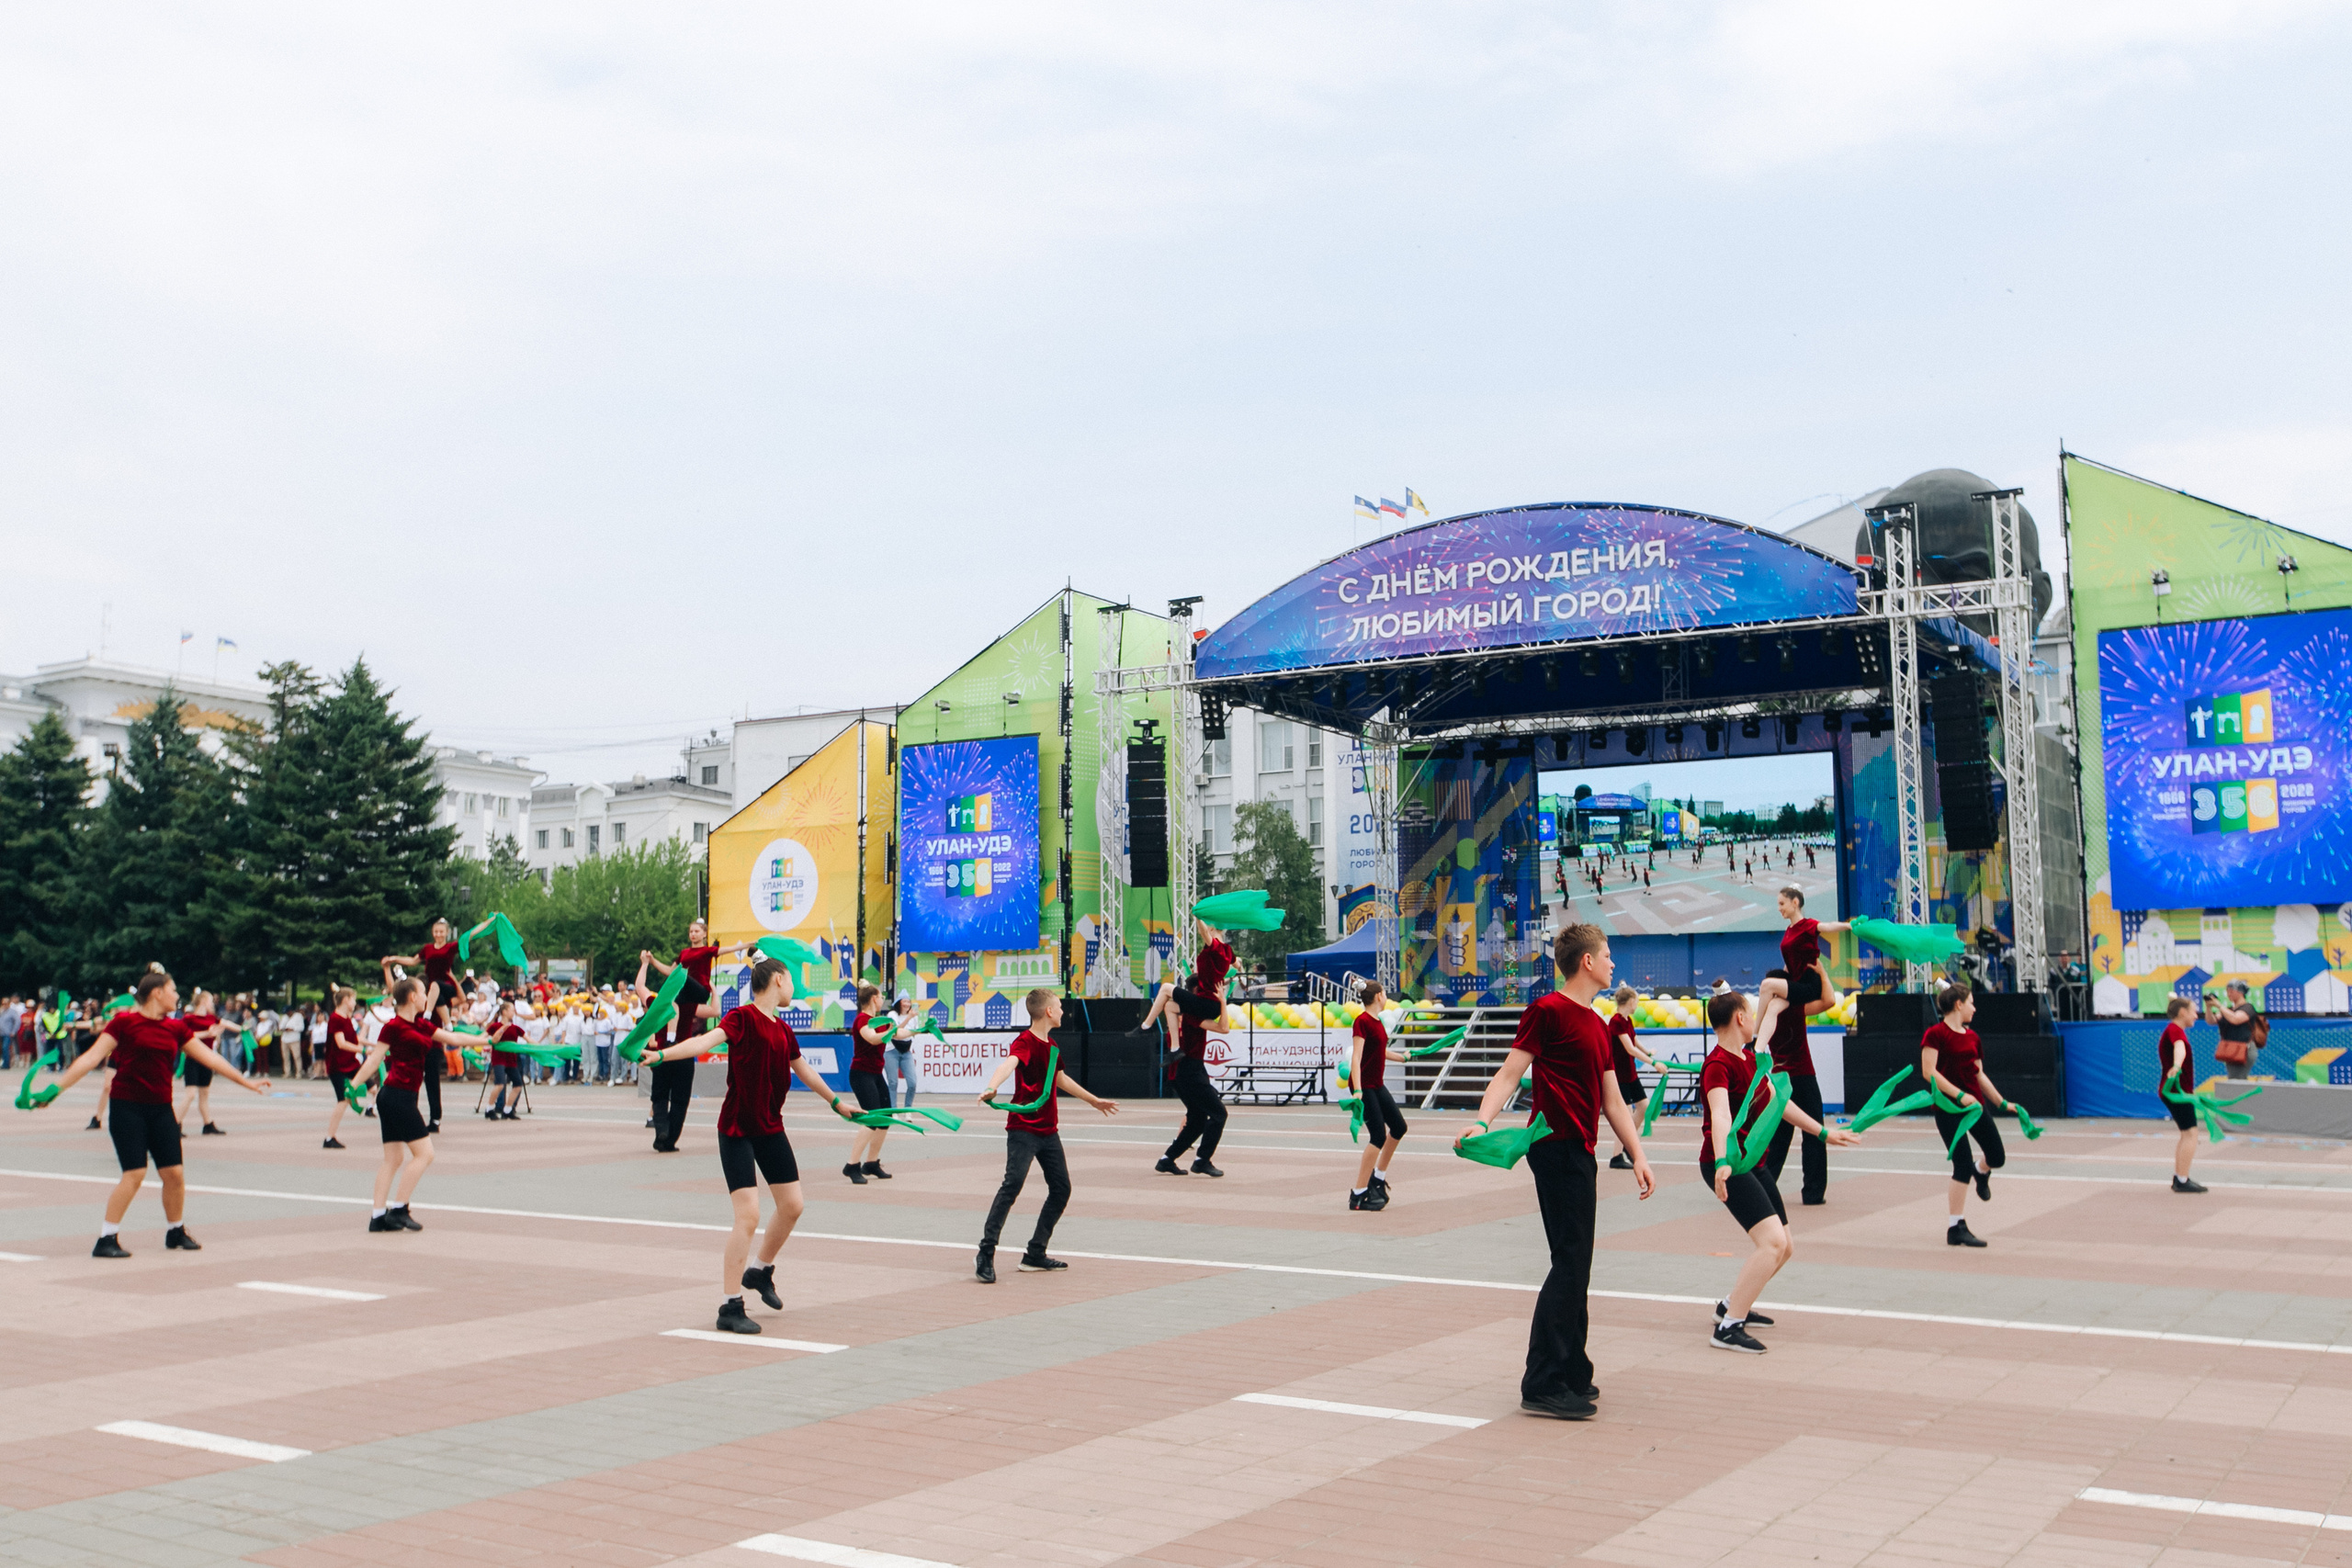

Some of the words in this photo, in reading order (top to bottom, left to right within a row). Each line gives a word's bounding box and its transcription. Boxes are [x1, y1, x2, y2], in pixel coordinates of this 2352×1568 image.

[1338, 578, 1360, 604] С
[1366, 564, 1458, 604] ДНЁМ
[1468, 539, 1675, 588] РОЖДЕНИЯ,
[1348, 593, 1523, 642] ЛЮБИМЫЙ
[1533, 584, 1660, 622] ГОРОД!
[2152, 746, 2313, 779] УЛАН-УДЭ
[2279, 783, 2314, 798] 2022
[2193, 784, 2275, 821] 356
[1351, 813, 1398, 834] 20
[926, 835, 1012, 856] УЛАН-УДЭ
[946, 863, 990, 888] 356
[993, 863, 1012, 872] 2022
[762, 879, 804, 890] УЛАН-УДЭ
[923, 1043, 1011, 1057] ВЕРТОЛЕТЫ
[923, 1063, 982, 1077] РОССИИ
